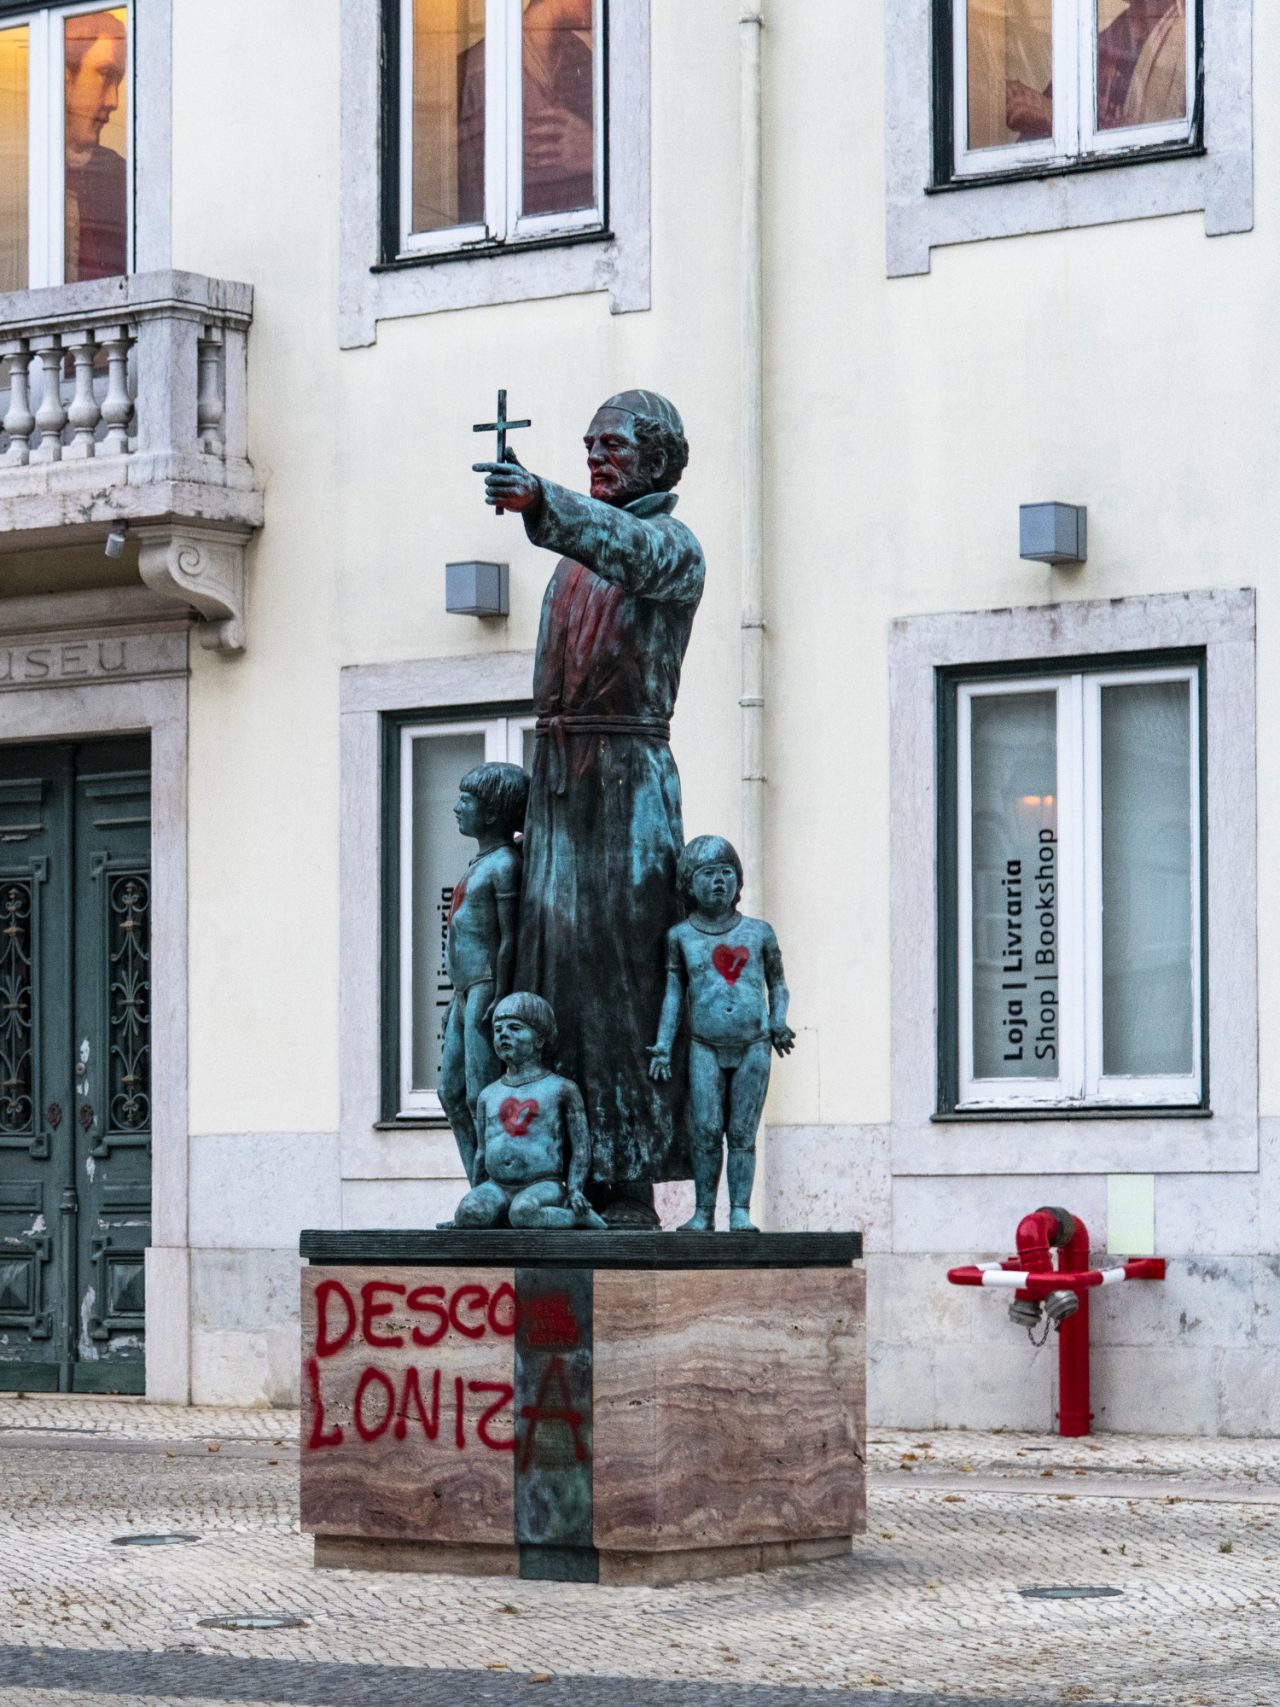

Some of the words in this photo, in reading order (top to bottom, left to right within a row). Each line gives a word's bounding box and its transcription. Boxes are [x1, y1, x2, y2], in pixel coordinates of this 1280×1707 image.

[1001, 860, 1023, 972] Livraria
[1034, 828, 1058, 965] Bookshop
[1002, 1000, 1029, 1061] Loja
[1034, 989, 1059, 1060] Shop
[315, 1279, 523, 1359] DESCO
